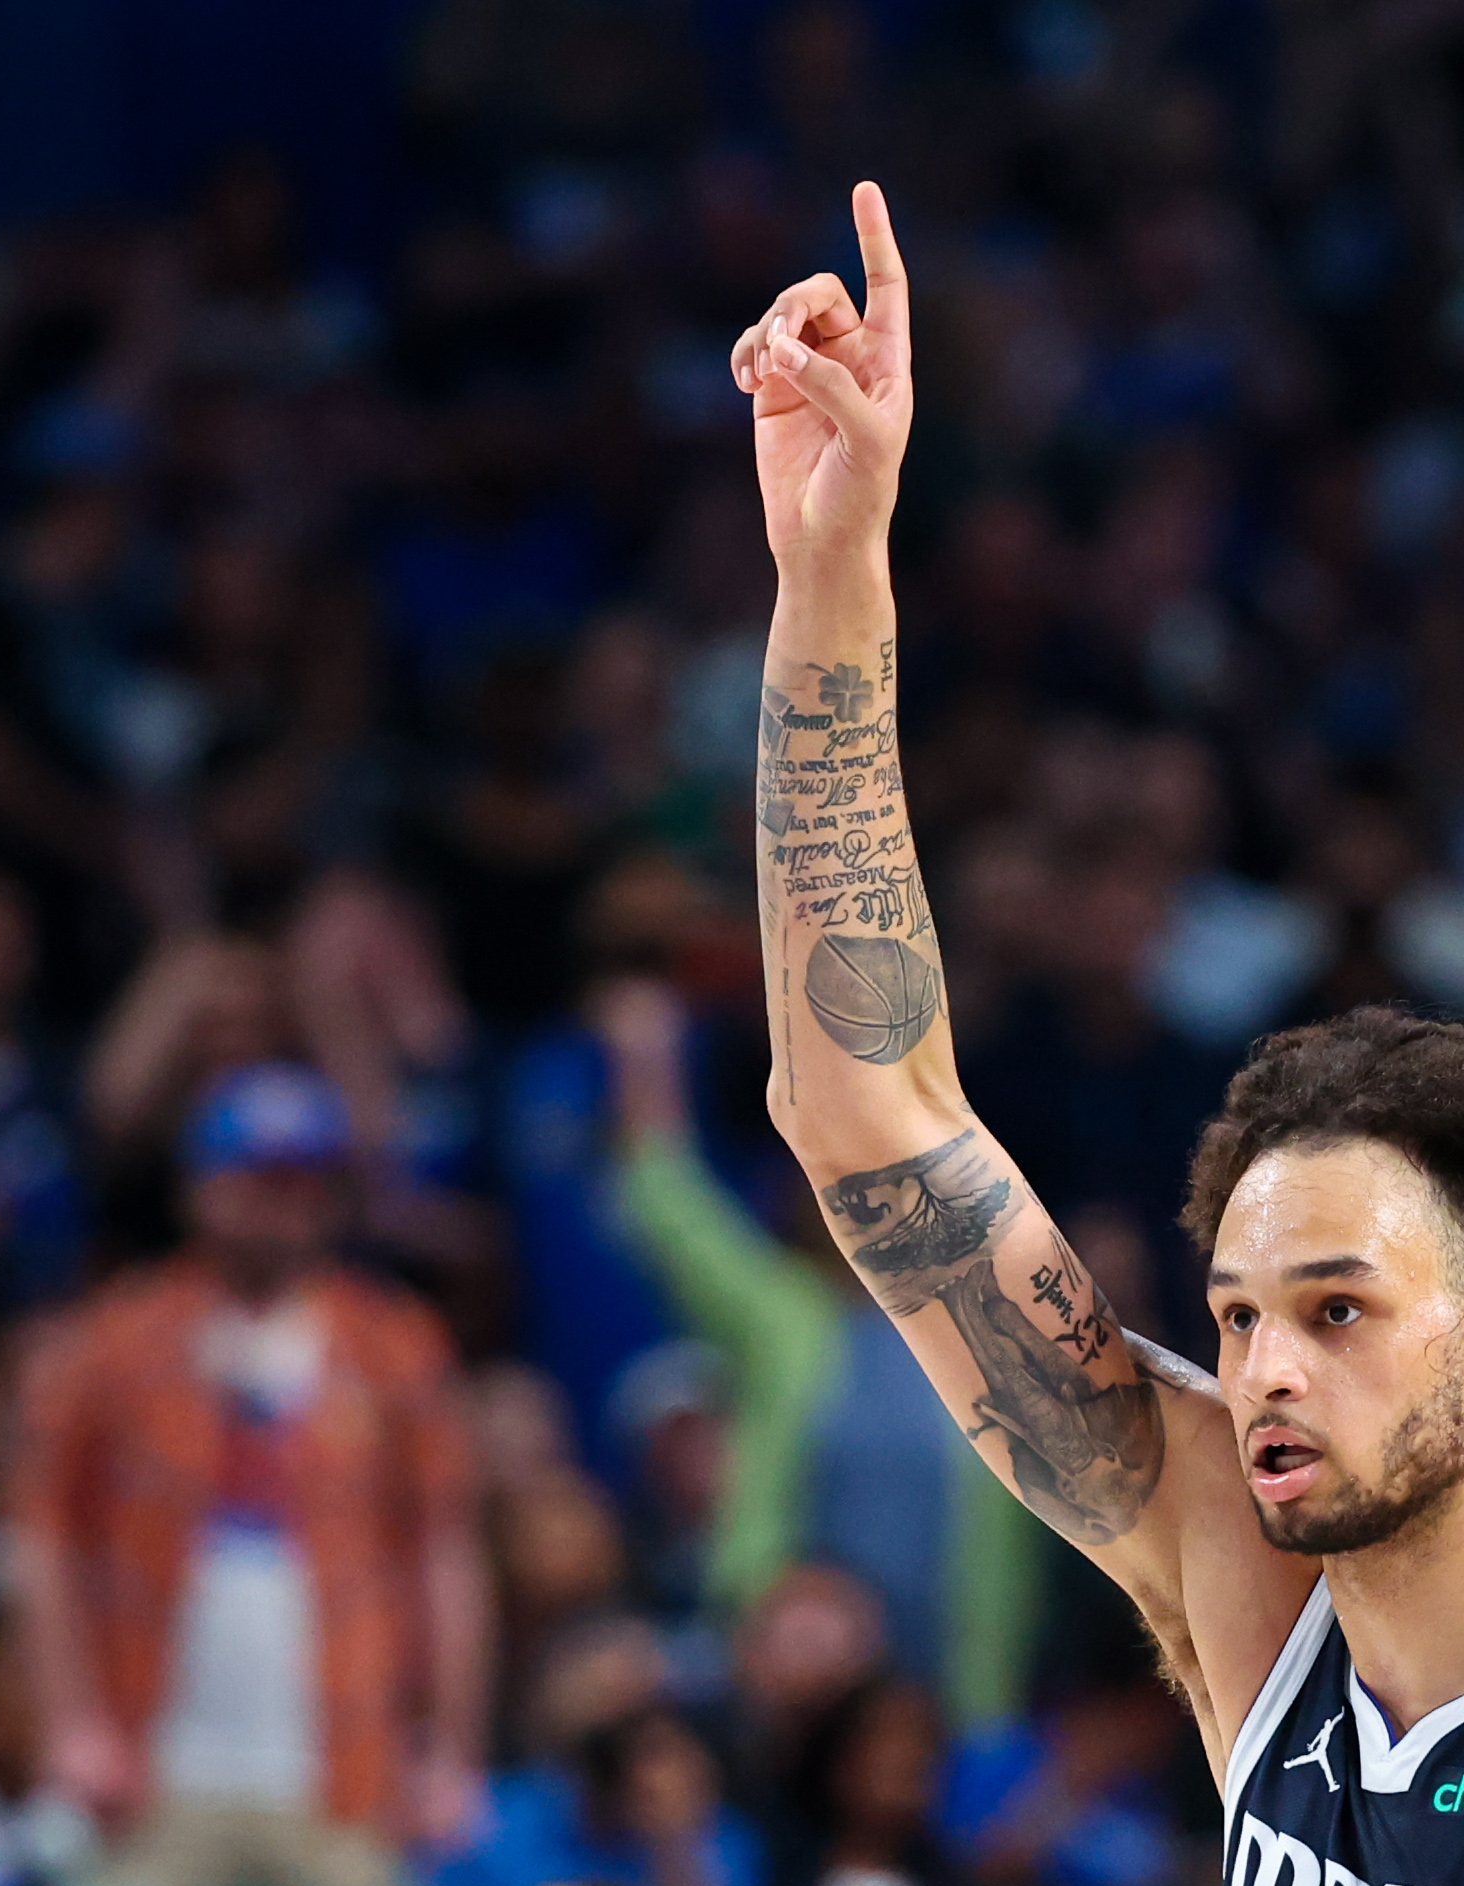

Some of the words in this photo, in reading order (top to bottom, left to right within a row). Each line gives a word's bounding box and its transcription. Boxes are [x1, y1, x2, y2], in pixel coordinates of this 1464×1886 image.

[879, 638, 894, 693] D4L
[788, 812, 810, 834] by
[813, 815, 839, 830] but
[880, 804, 895, 818] we
[783, 865, 887, 896] Measured
[852, 858, 932, 940] Life
